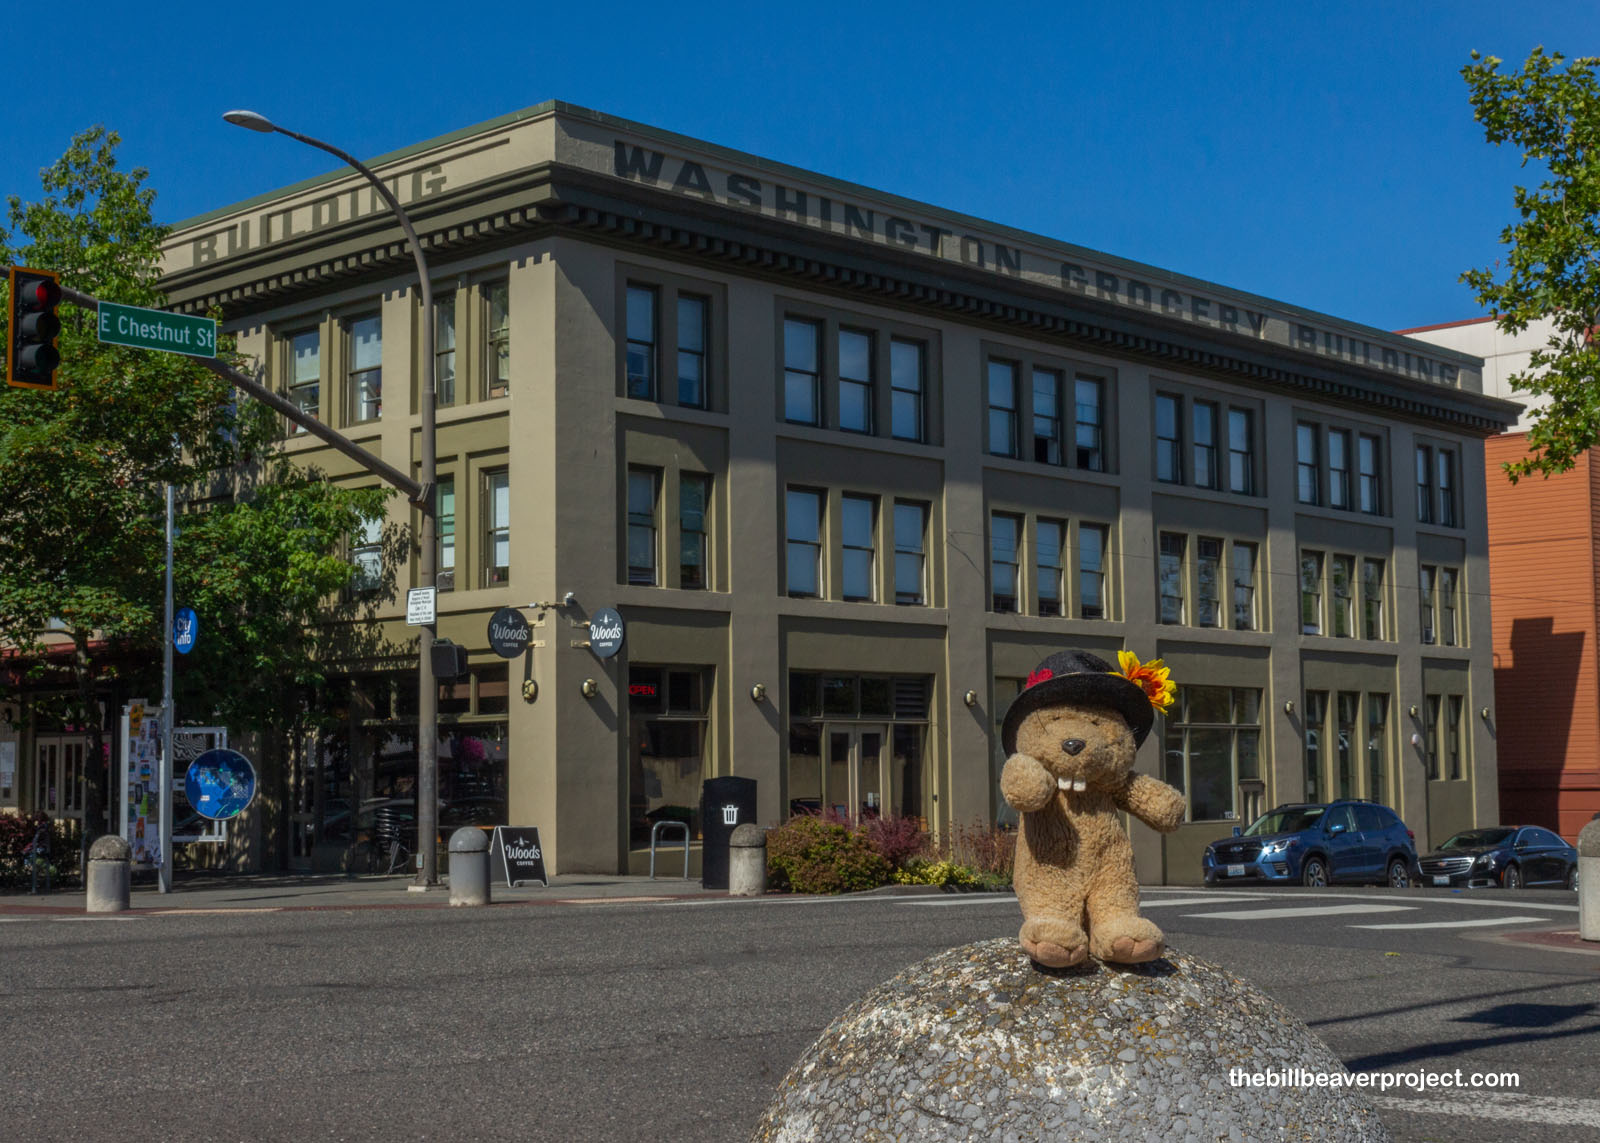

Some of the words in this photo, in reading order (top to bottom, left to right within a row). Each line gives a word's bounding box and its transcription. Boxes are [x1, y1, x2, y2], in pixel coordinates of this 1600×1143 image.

[193, 164, 447, 268] BUILDING
[614, 139, 1021, 279] WASHINGTON
[1060, 262, 1267, 338] GROCERY
[1296, 323, 1459, 388] BUILDING
[101, 311, 111, 332] E
[118, 315, 191, 345] Chestnut
[196, 327, 213, 348] St
[177, 617, 192, 633] City
[492, 623, 528, 641] Woods
[590, 624, 622, 640] Woods
[629, 685, 655, 695] OPEN
[505, 844, 541, 859] Woods
